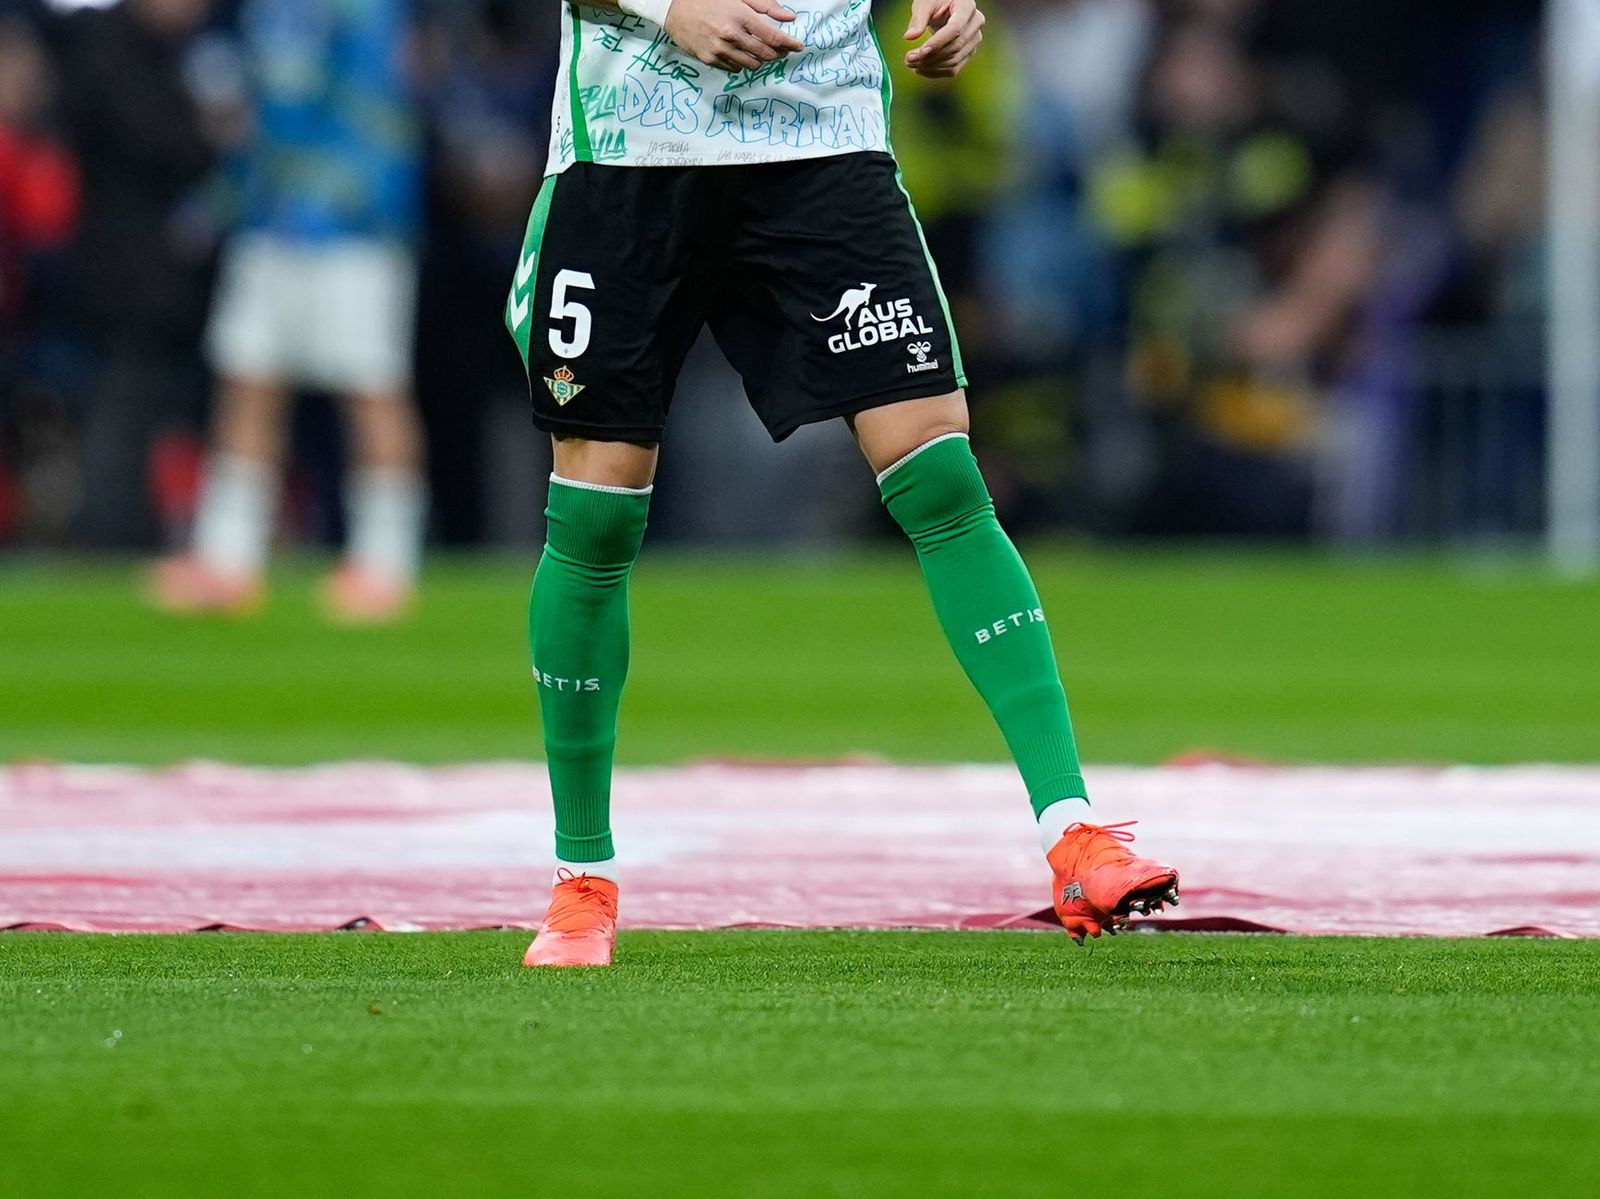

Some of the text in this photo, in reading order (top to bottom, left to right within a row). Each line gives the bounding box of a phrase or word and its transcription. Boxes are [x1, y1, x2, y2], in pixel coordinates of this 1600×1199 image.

[592, 27, 623, 52] DEL
[626, 31, 700, 92] ALCOR
[548, 268, 596, 359] 5
[858, 298, 913, 328] AUS
[828, 315, 933, 354] GLOBAL
[906, 359, 939, 373] hummel
[974, 607, 1045, 644] BETIS
[532, 665, 600, 692] BETIS
